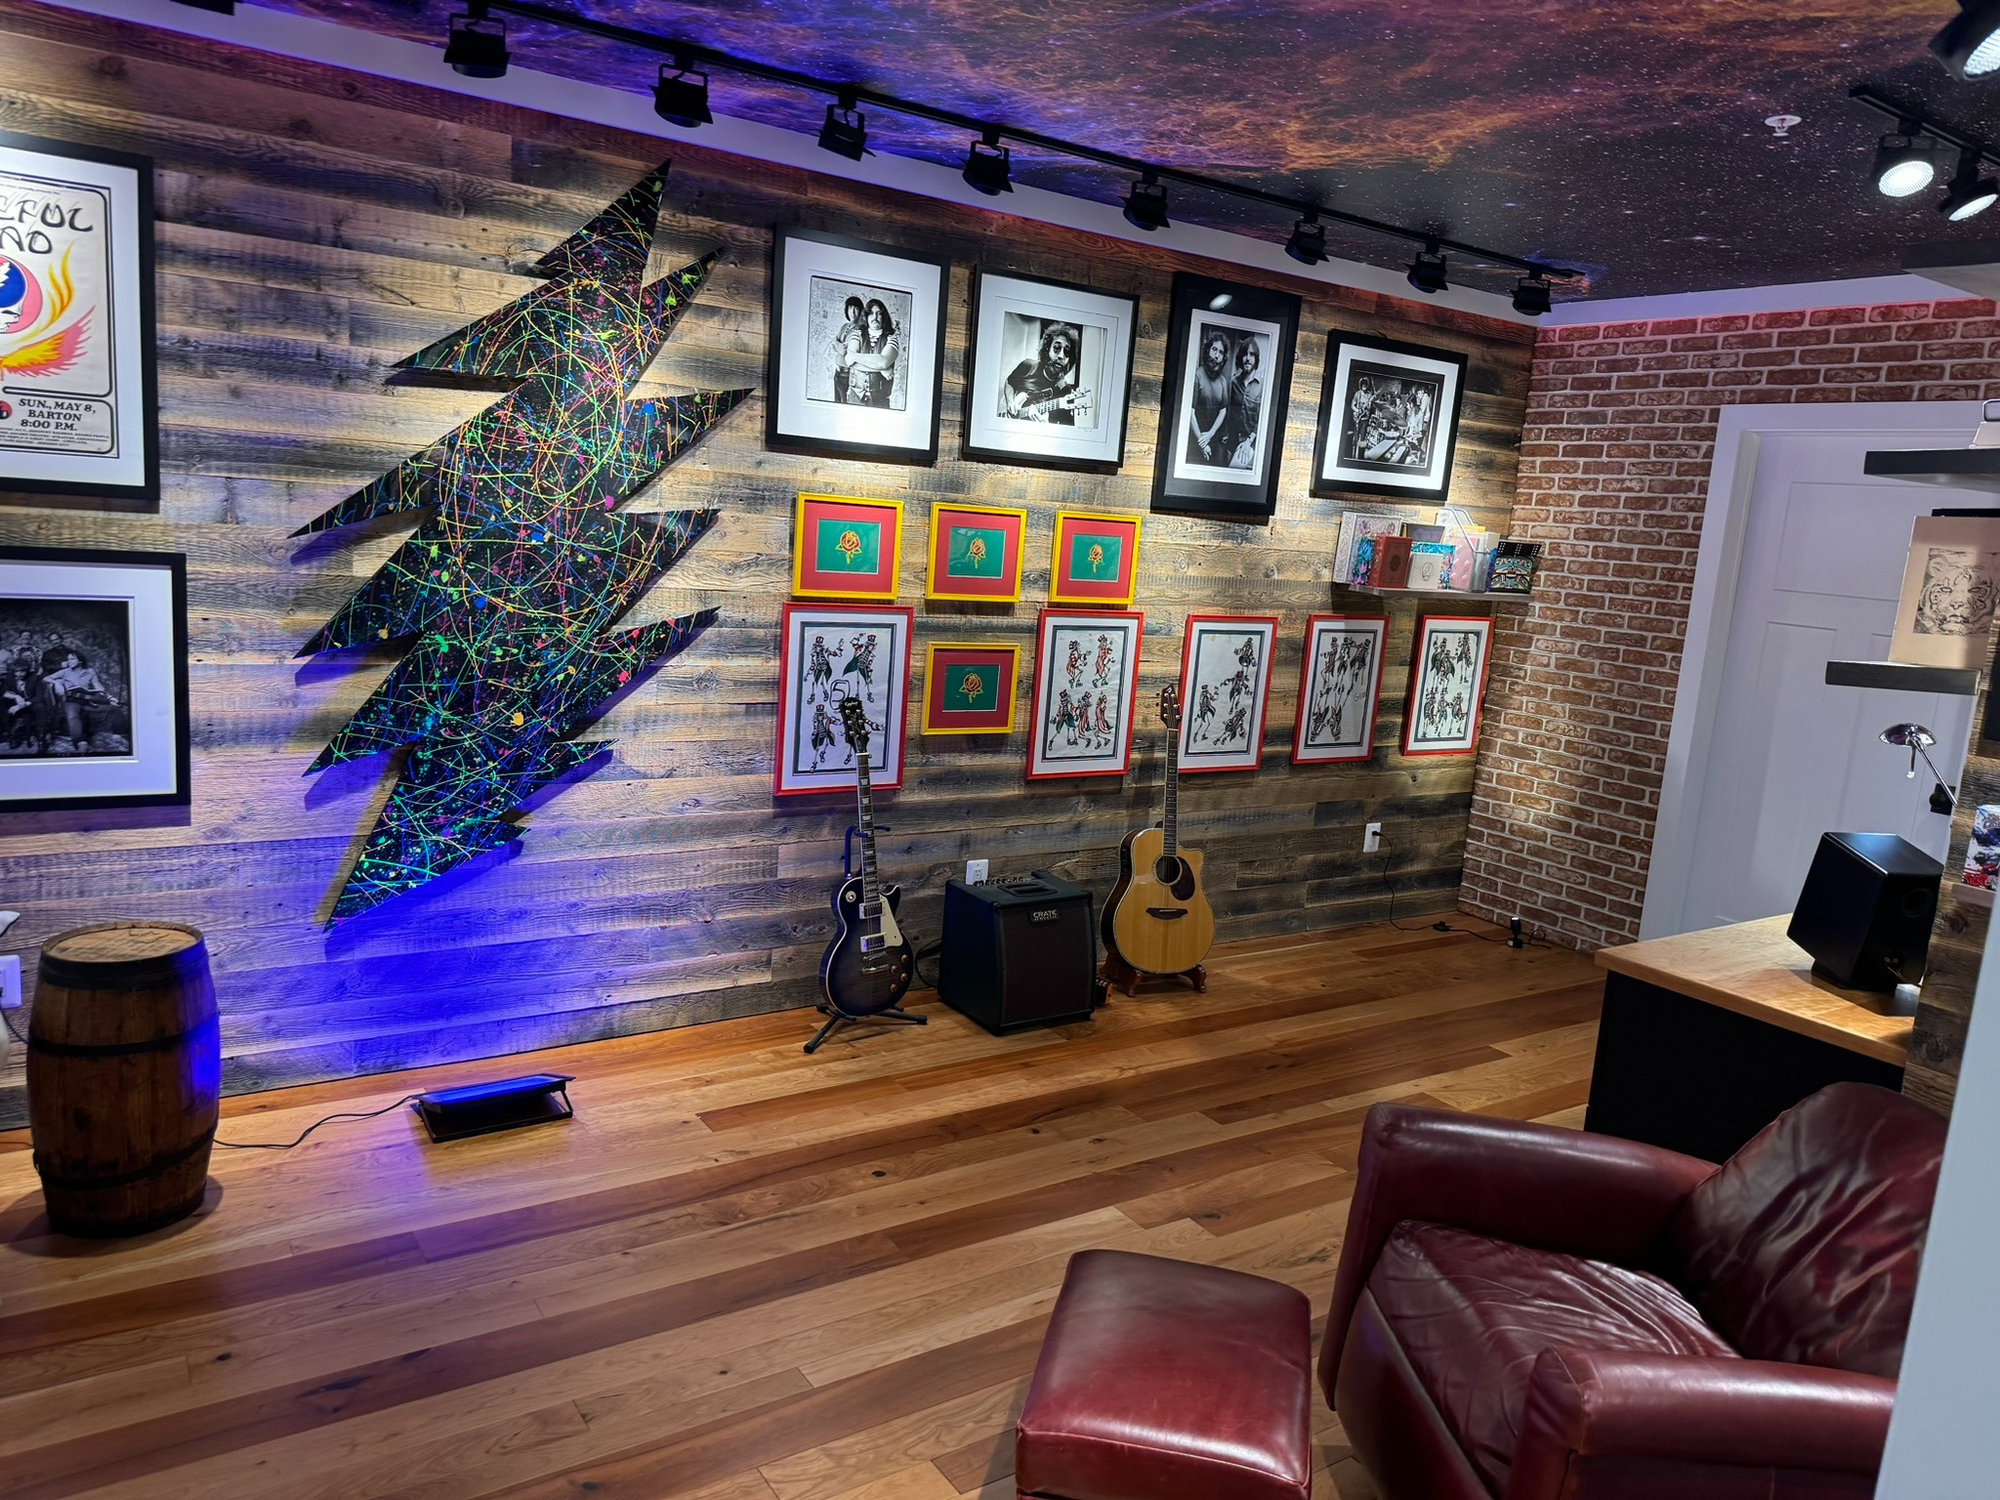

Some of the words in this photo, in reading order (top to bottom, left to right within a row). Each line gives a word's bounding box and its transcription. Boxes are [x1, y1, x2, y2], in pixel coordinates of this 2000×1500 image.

[53, 401, 82, 411] MAY
[84, 404, 96, 414] 8,
[28, 409, 82, 421] BARTON
[20, 419, 51, 429] 8:00
[54, 421, 77, 431] P.M.
[1032, 909, 1058, 918] CRATE
